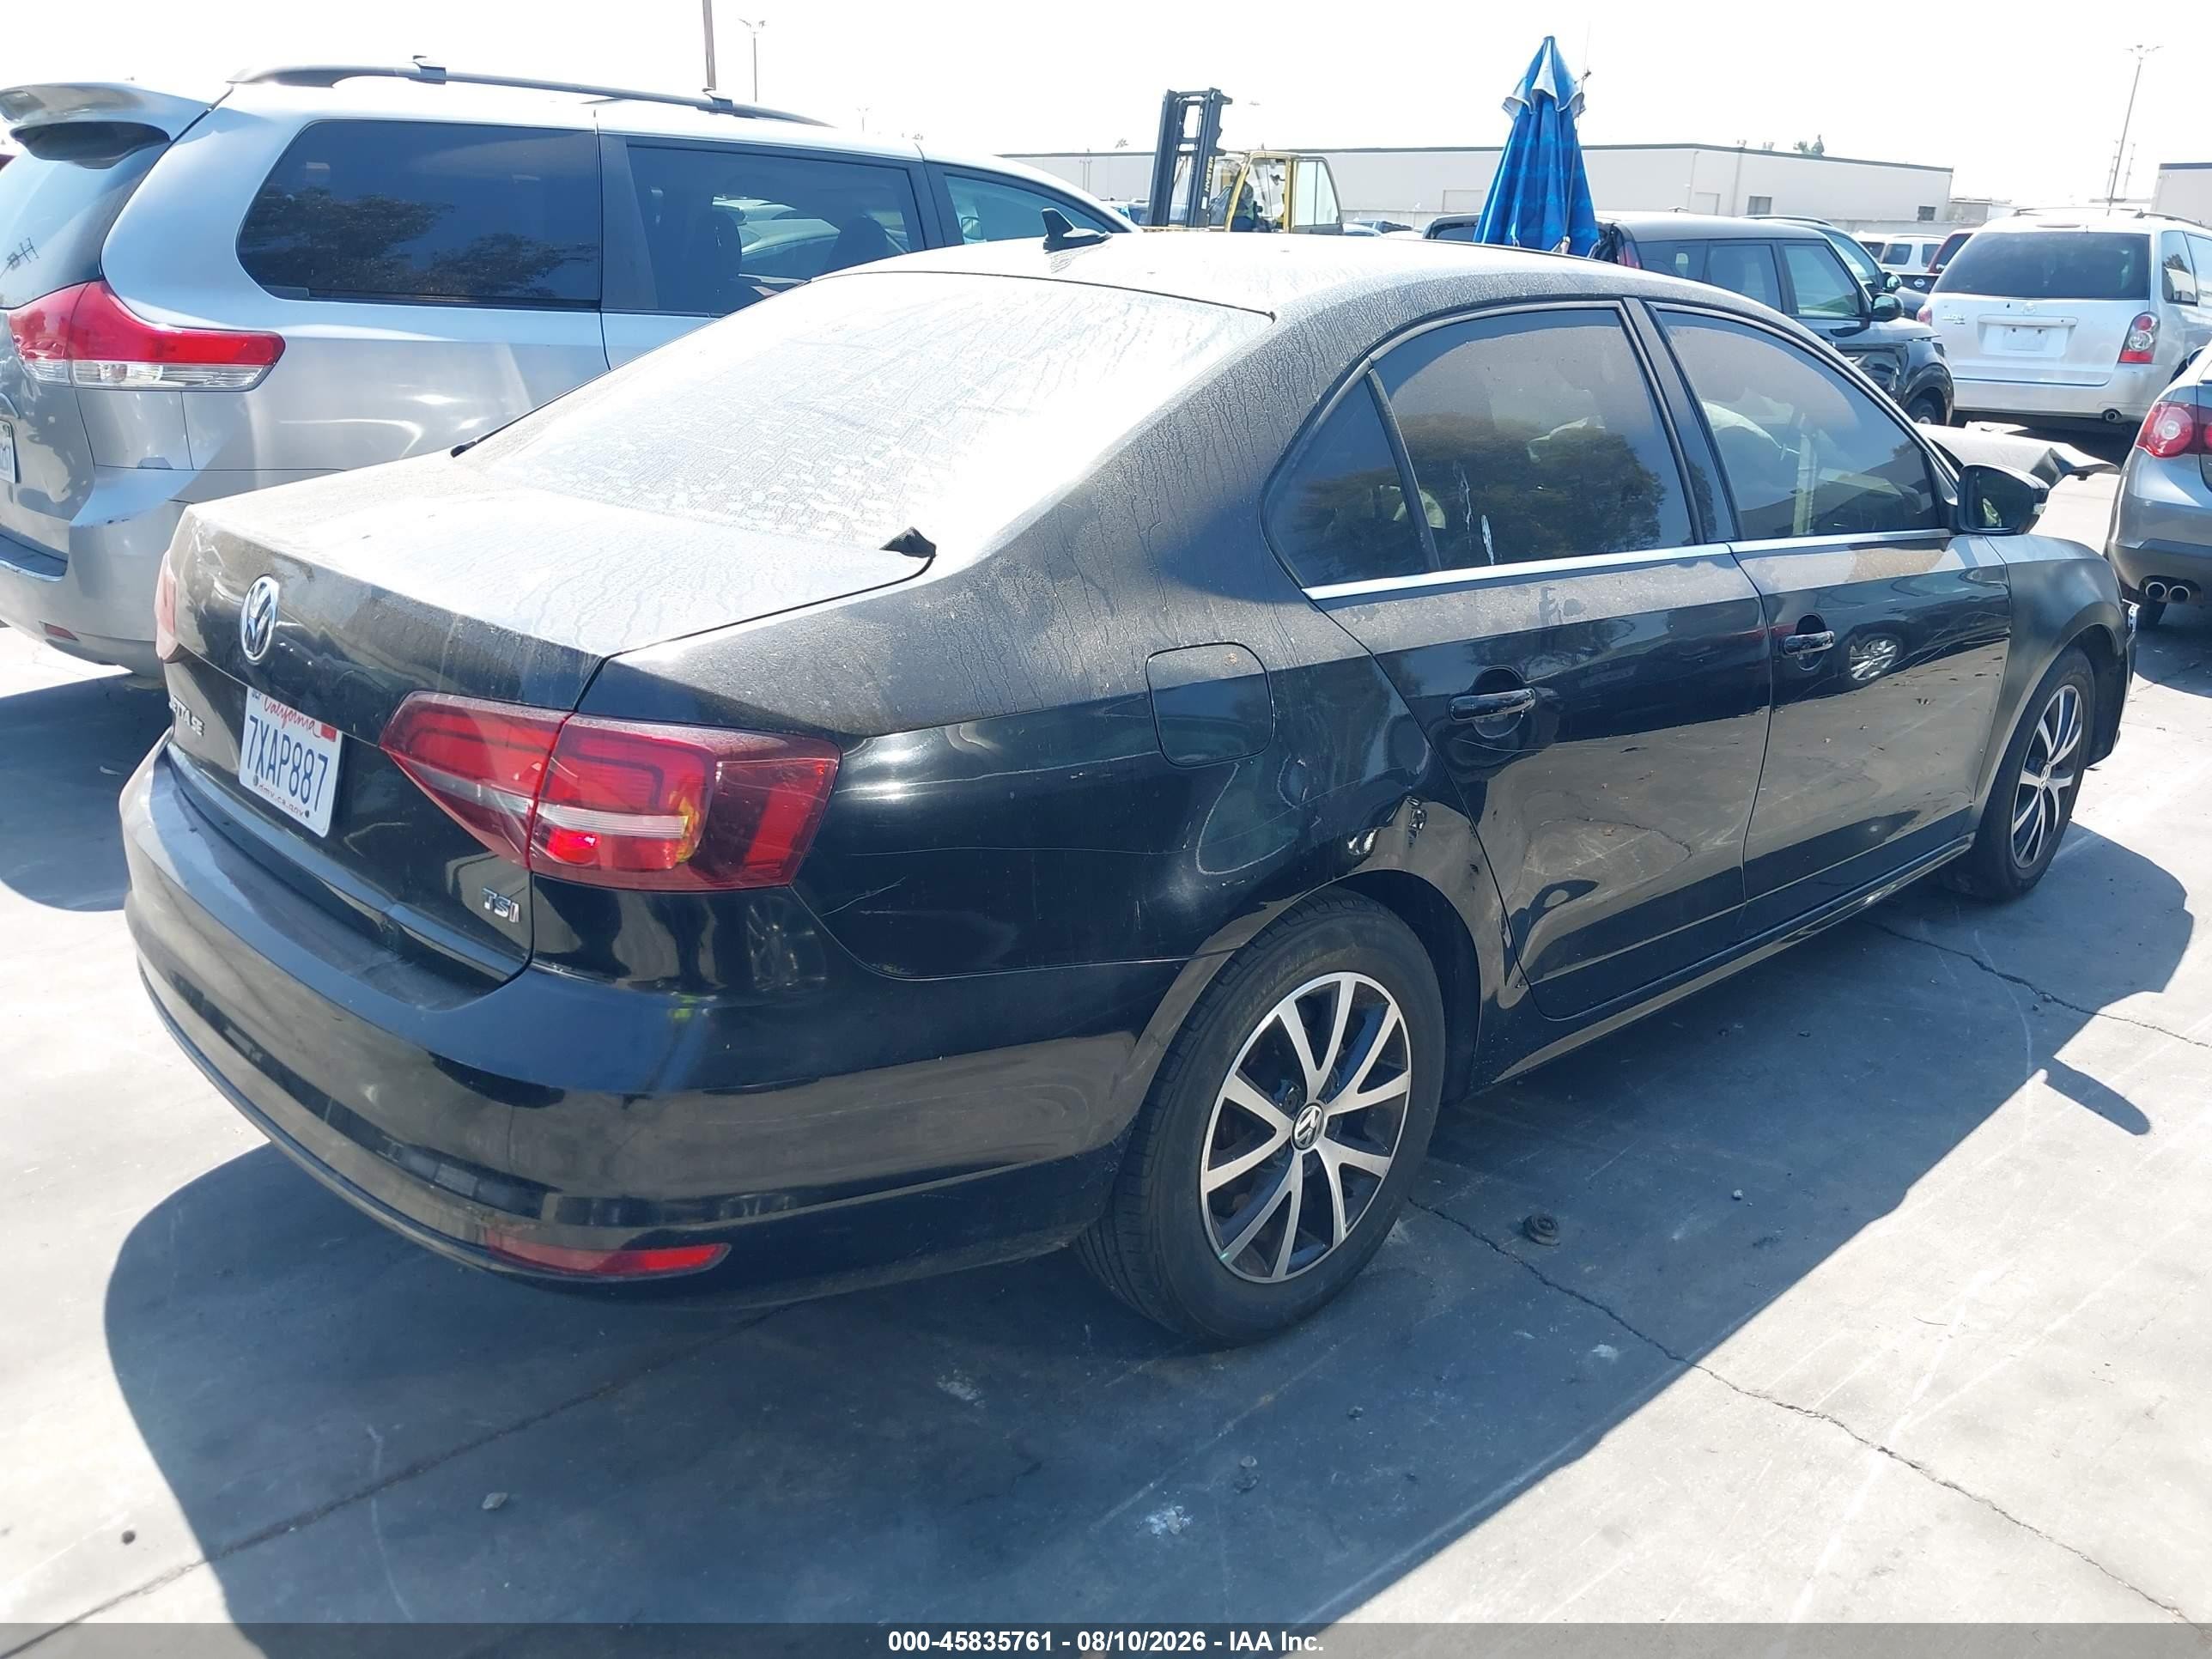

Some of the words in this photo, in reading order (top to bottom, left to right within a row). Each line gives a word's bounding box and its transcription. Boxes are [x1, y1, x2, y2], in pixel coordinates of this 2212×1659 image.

[1204, 155, 1214, 192] HYSTER
[191, 715, 205, 737] SE
[264, 696, 321, 738] California
[246, 714, 329, 813] 7XAP887
[482, 887, 520, 923] TSI
